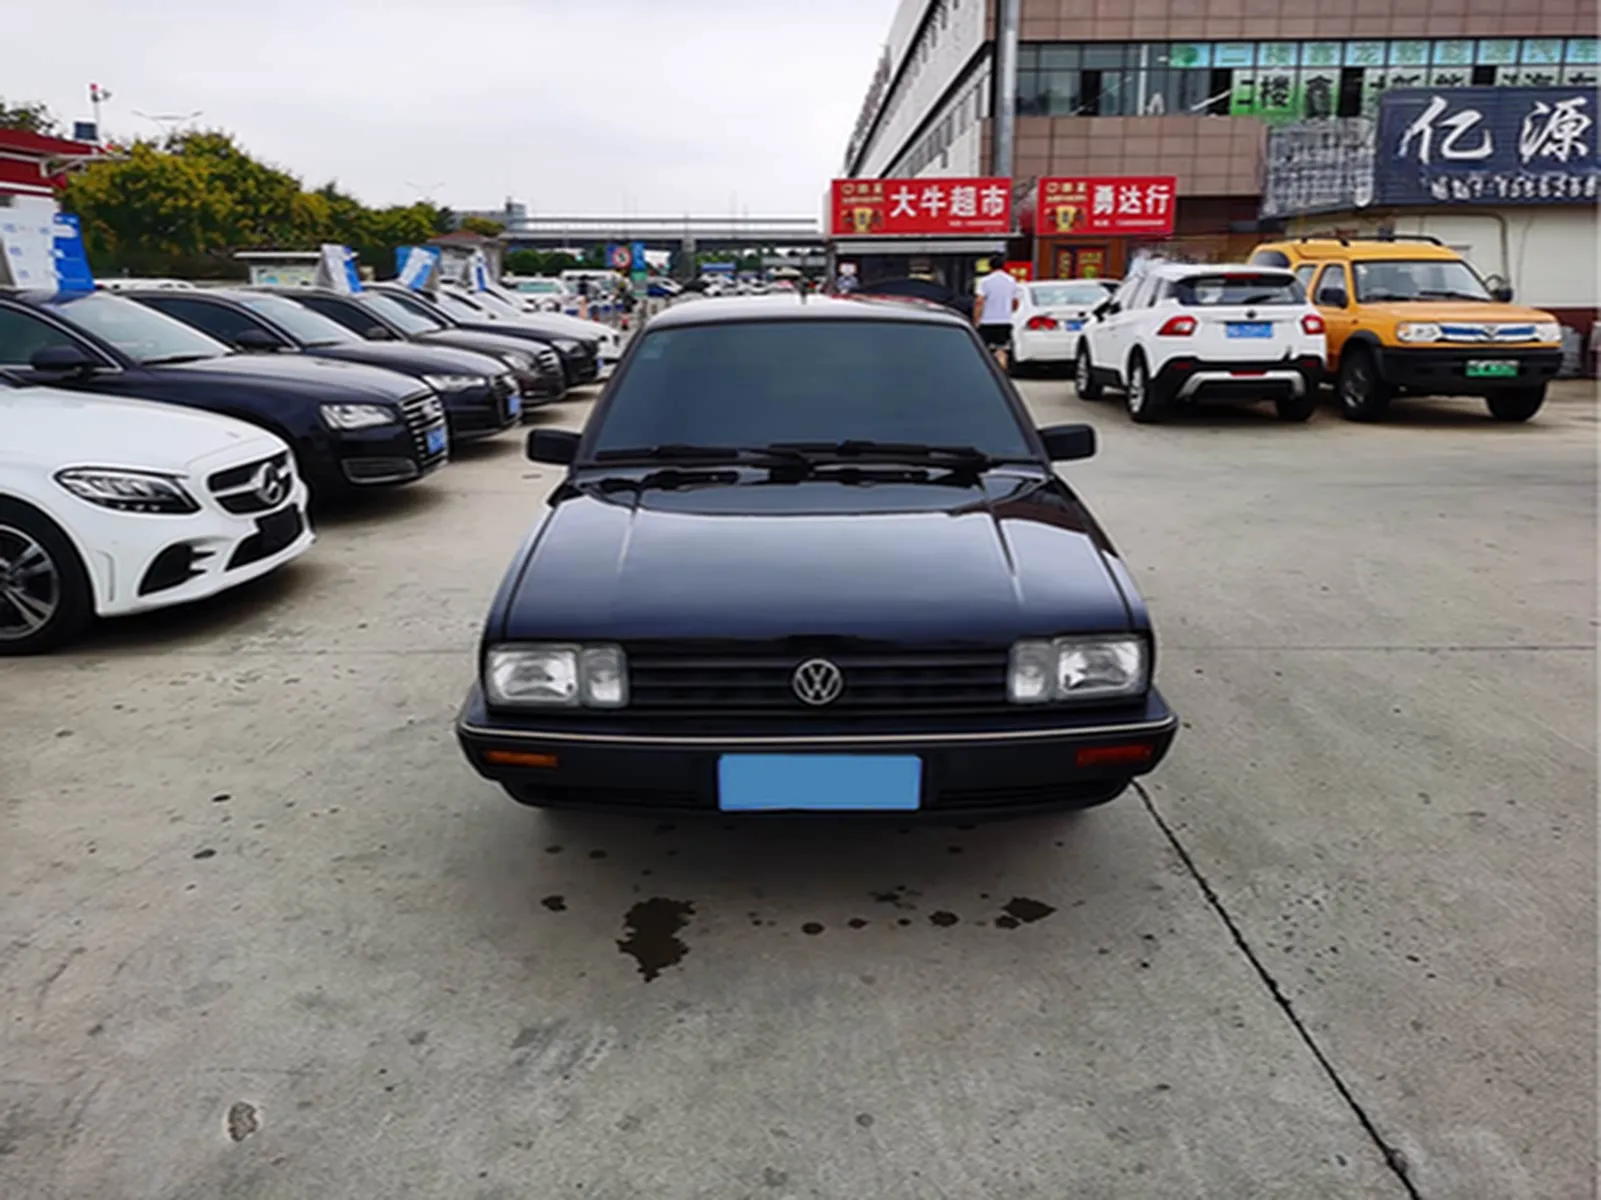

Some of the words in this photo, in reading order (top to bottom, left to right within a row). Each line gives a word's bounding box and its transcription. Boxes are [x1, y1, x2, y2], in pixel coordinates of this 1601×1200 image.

[1399, 96, 1592, 164] 亿源
[890, 185, 1007, 217] 大牛超市
[1093, 185, 1170, 215] 勇达行
